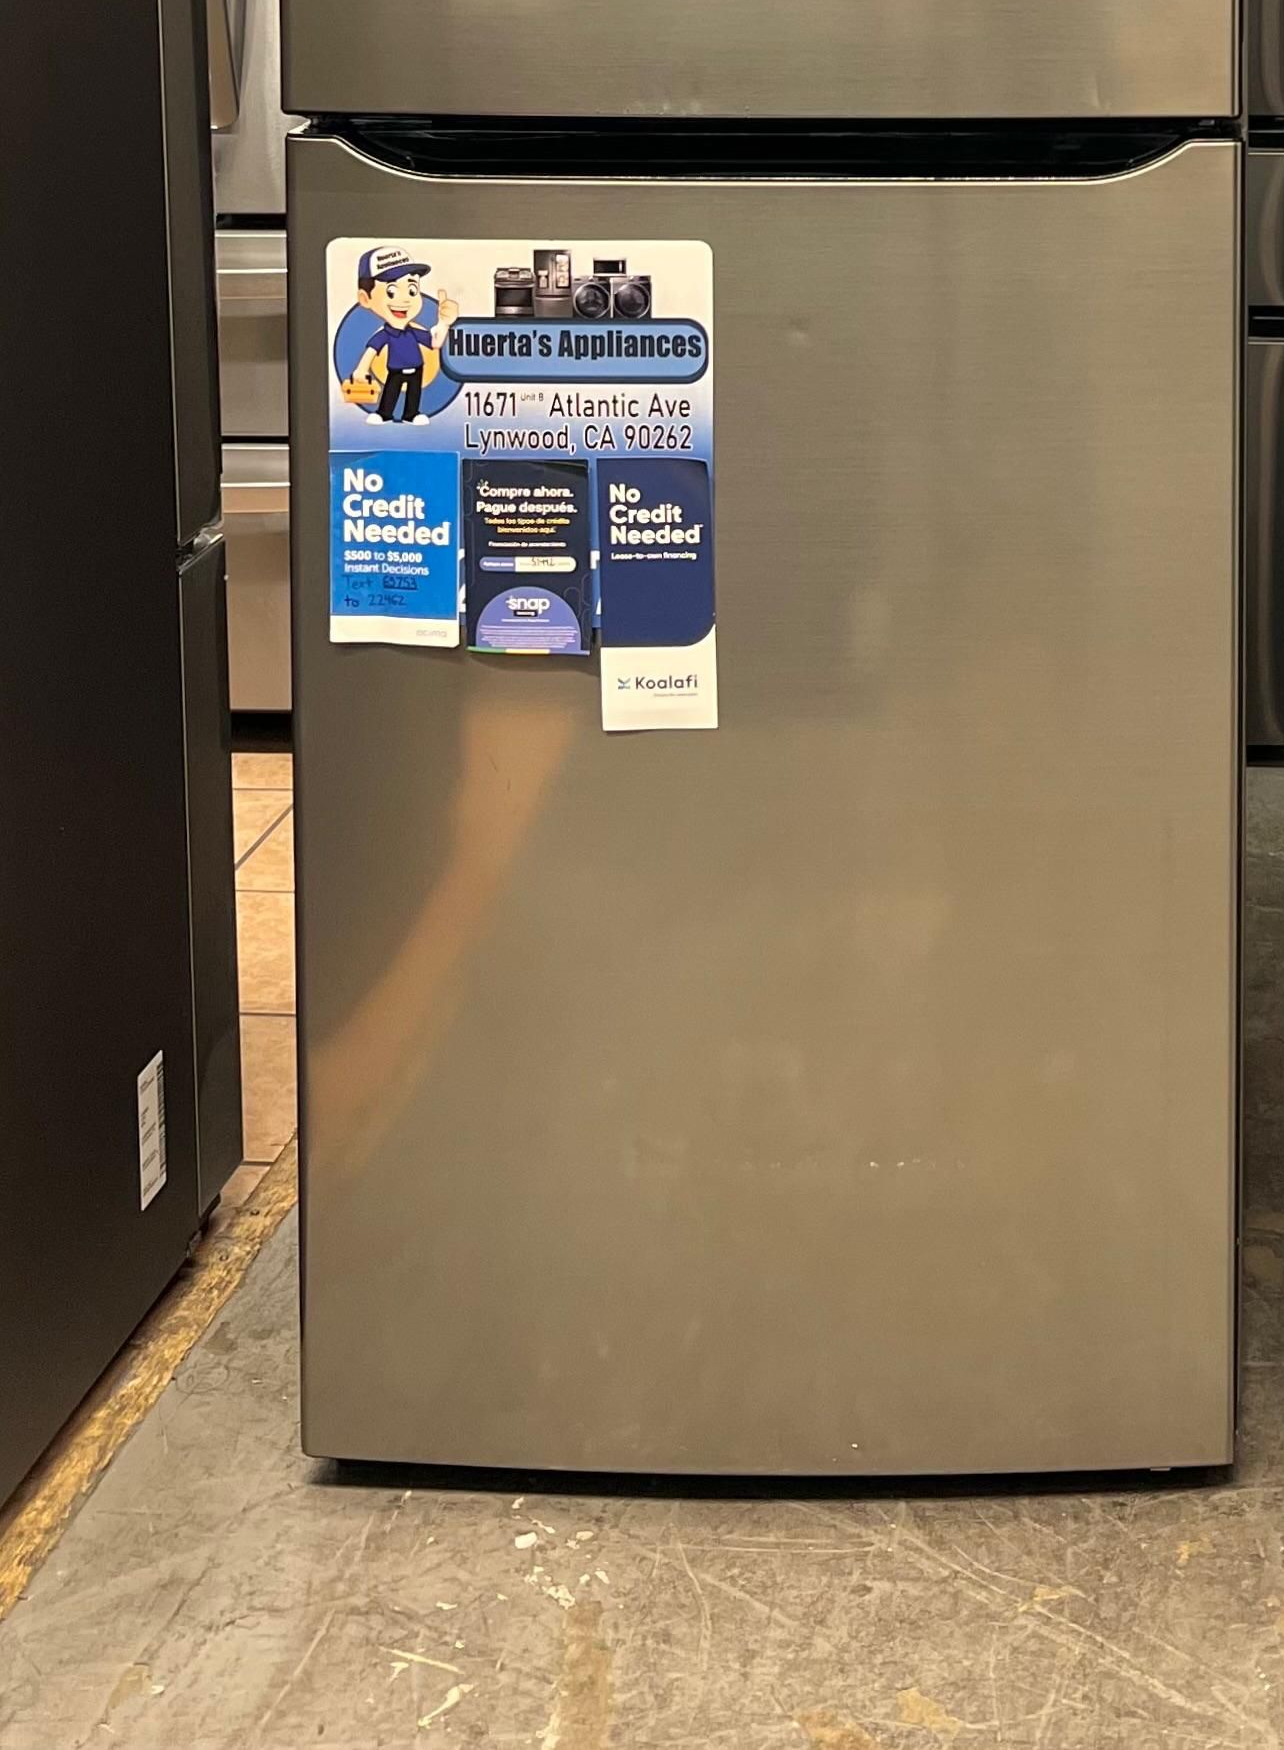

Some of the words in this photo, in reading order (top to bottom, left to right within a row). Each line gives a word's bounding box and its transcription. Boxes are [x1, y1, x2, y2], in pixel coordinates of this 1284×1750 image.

[448, 328, 552, 358] Huerta's
[558, 329, 702, 360] Appliances
[465, 391, 516, 416] 11671
[549, 392, 640, 418] Atlantic
[647, 392, 691, 418] Ave
[465, 423, 577, 454] Lynwood,
[584, 424, 616, 450] CA
[624, 424, 692, 450] 90262
[343, 468, 384, 492] No
[479, 485, 531, 499] Compre
[533, 486, 574, 497] ahora.
[609, 483, 641, 503] No
[342, 493, 425, 519] Credit
[476, 501, 517, 515] Pague
[518, 501, 578, 515] después.
[609, 503, 682, 523] Credit
[343, 519, 450, 546] Needed
[344, 550, 372, 561] $500
[374, 551, 386, 561] to
[387, 551, 423, 564] $5,000
[663, 551, 697, 561] financing
[344, 563, 380, 573] Instant
[381, 564, 429, 576] Decisions
[344, 594, 361, 608] to
[507, 597, 551, 614] snap
[635, 674, 698, 690] Koalafi
